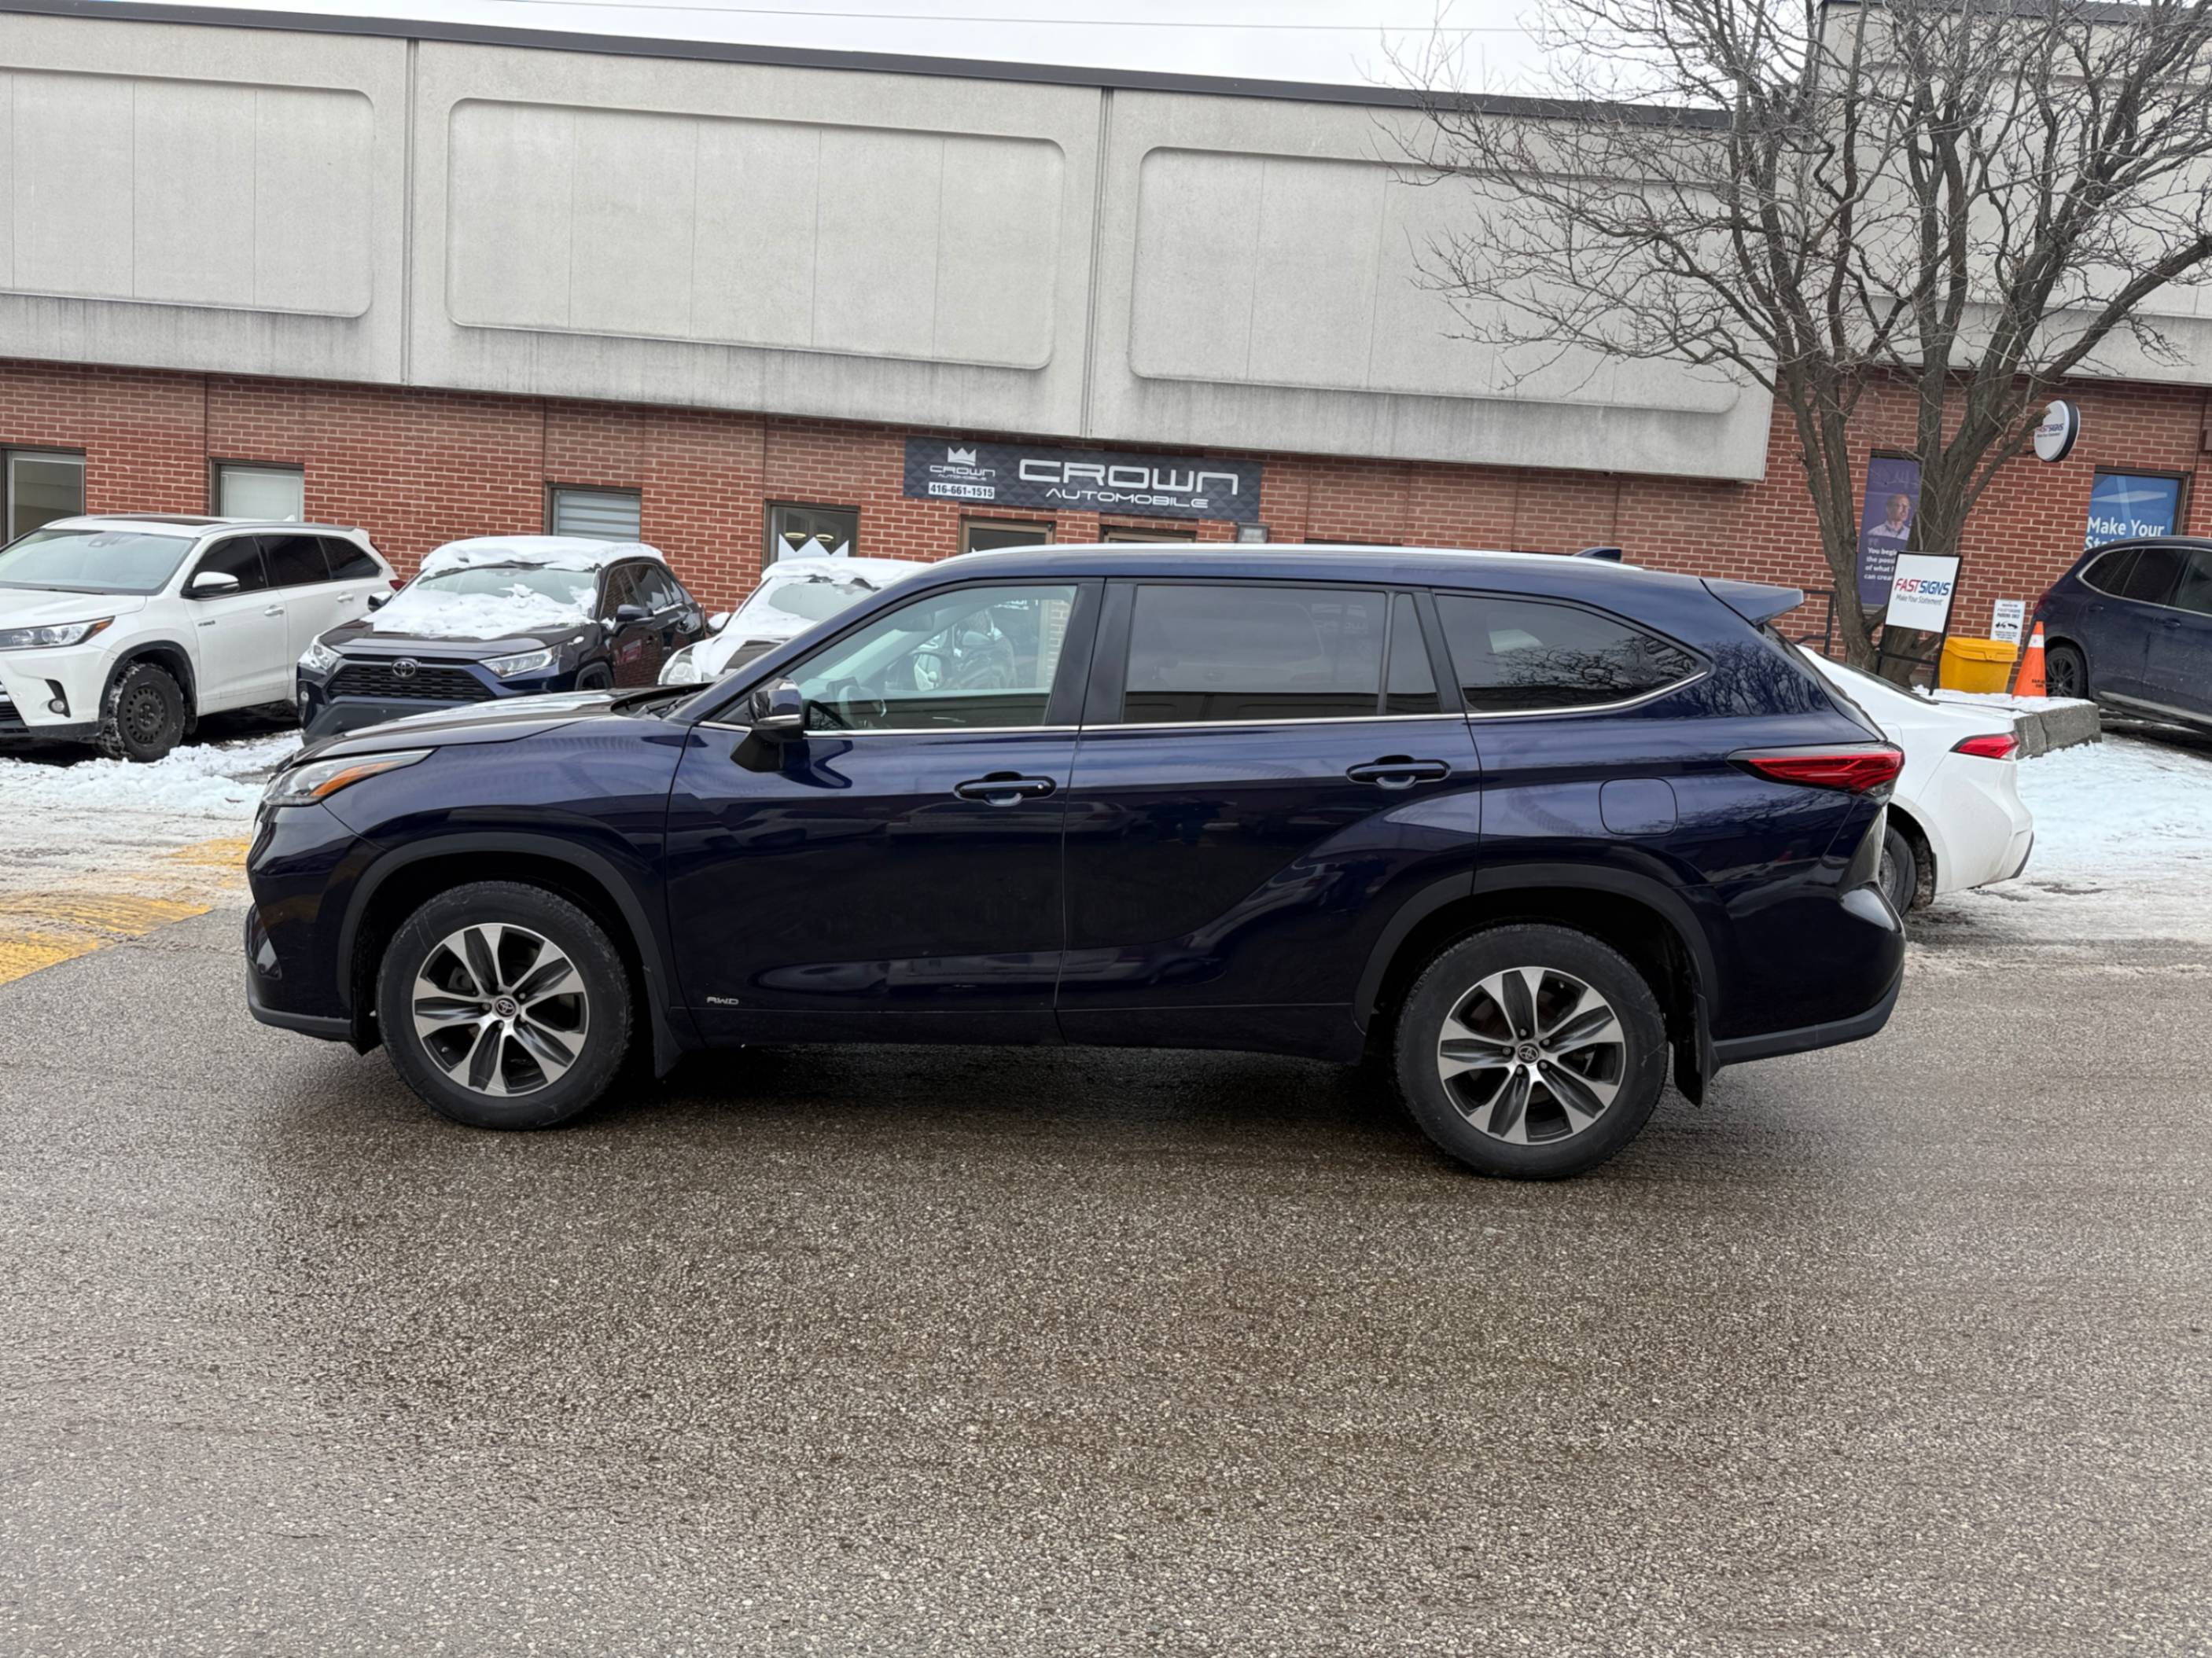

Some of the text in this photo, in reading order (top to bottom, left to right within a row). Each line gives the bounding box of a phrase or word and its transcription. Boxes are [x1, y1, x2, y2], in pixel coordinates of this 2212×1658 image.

[929, 465, 996, 477] CROWN
[1019, 458, 1239, 495] CROWN
[930, 483, 994, 498] 416-661-1515
[1045, 487, 1209, 509] AUTOMOBILE
[2086, 516, 2165, 537] Make Your
[1894, 578, 1952, 596] FASTSIGNS
[707, 996, 739, 1005] AWD
